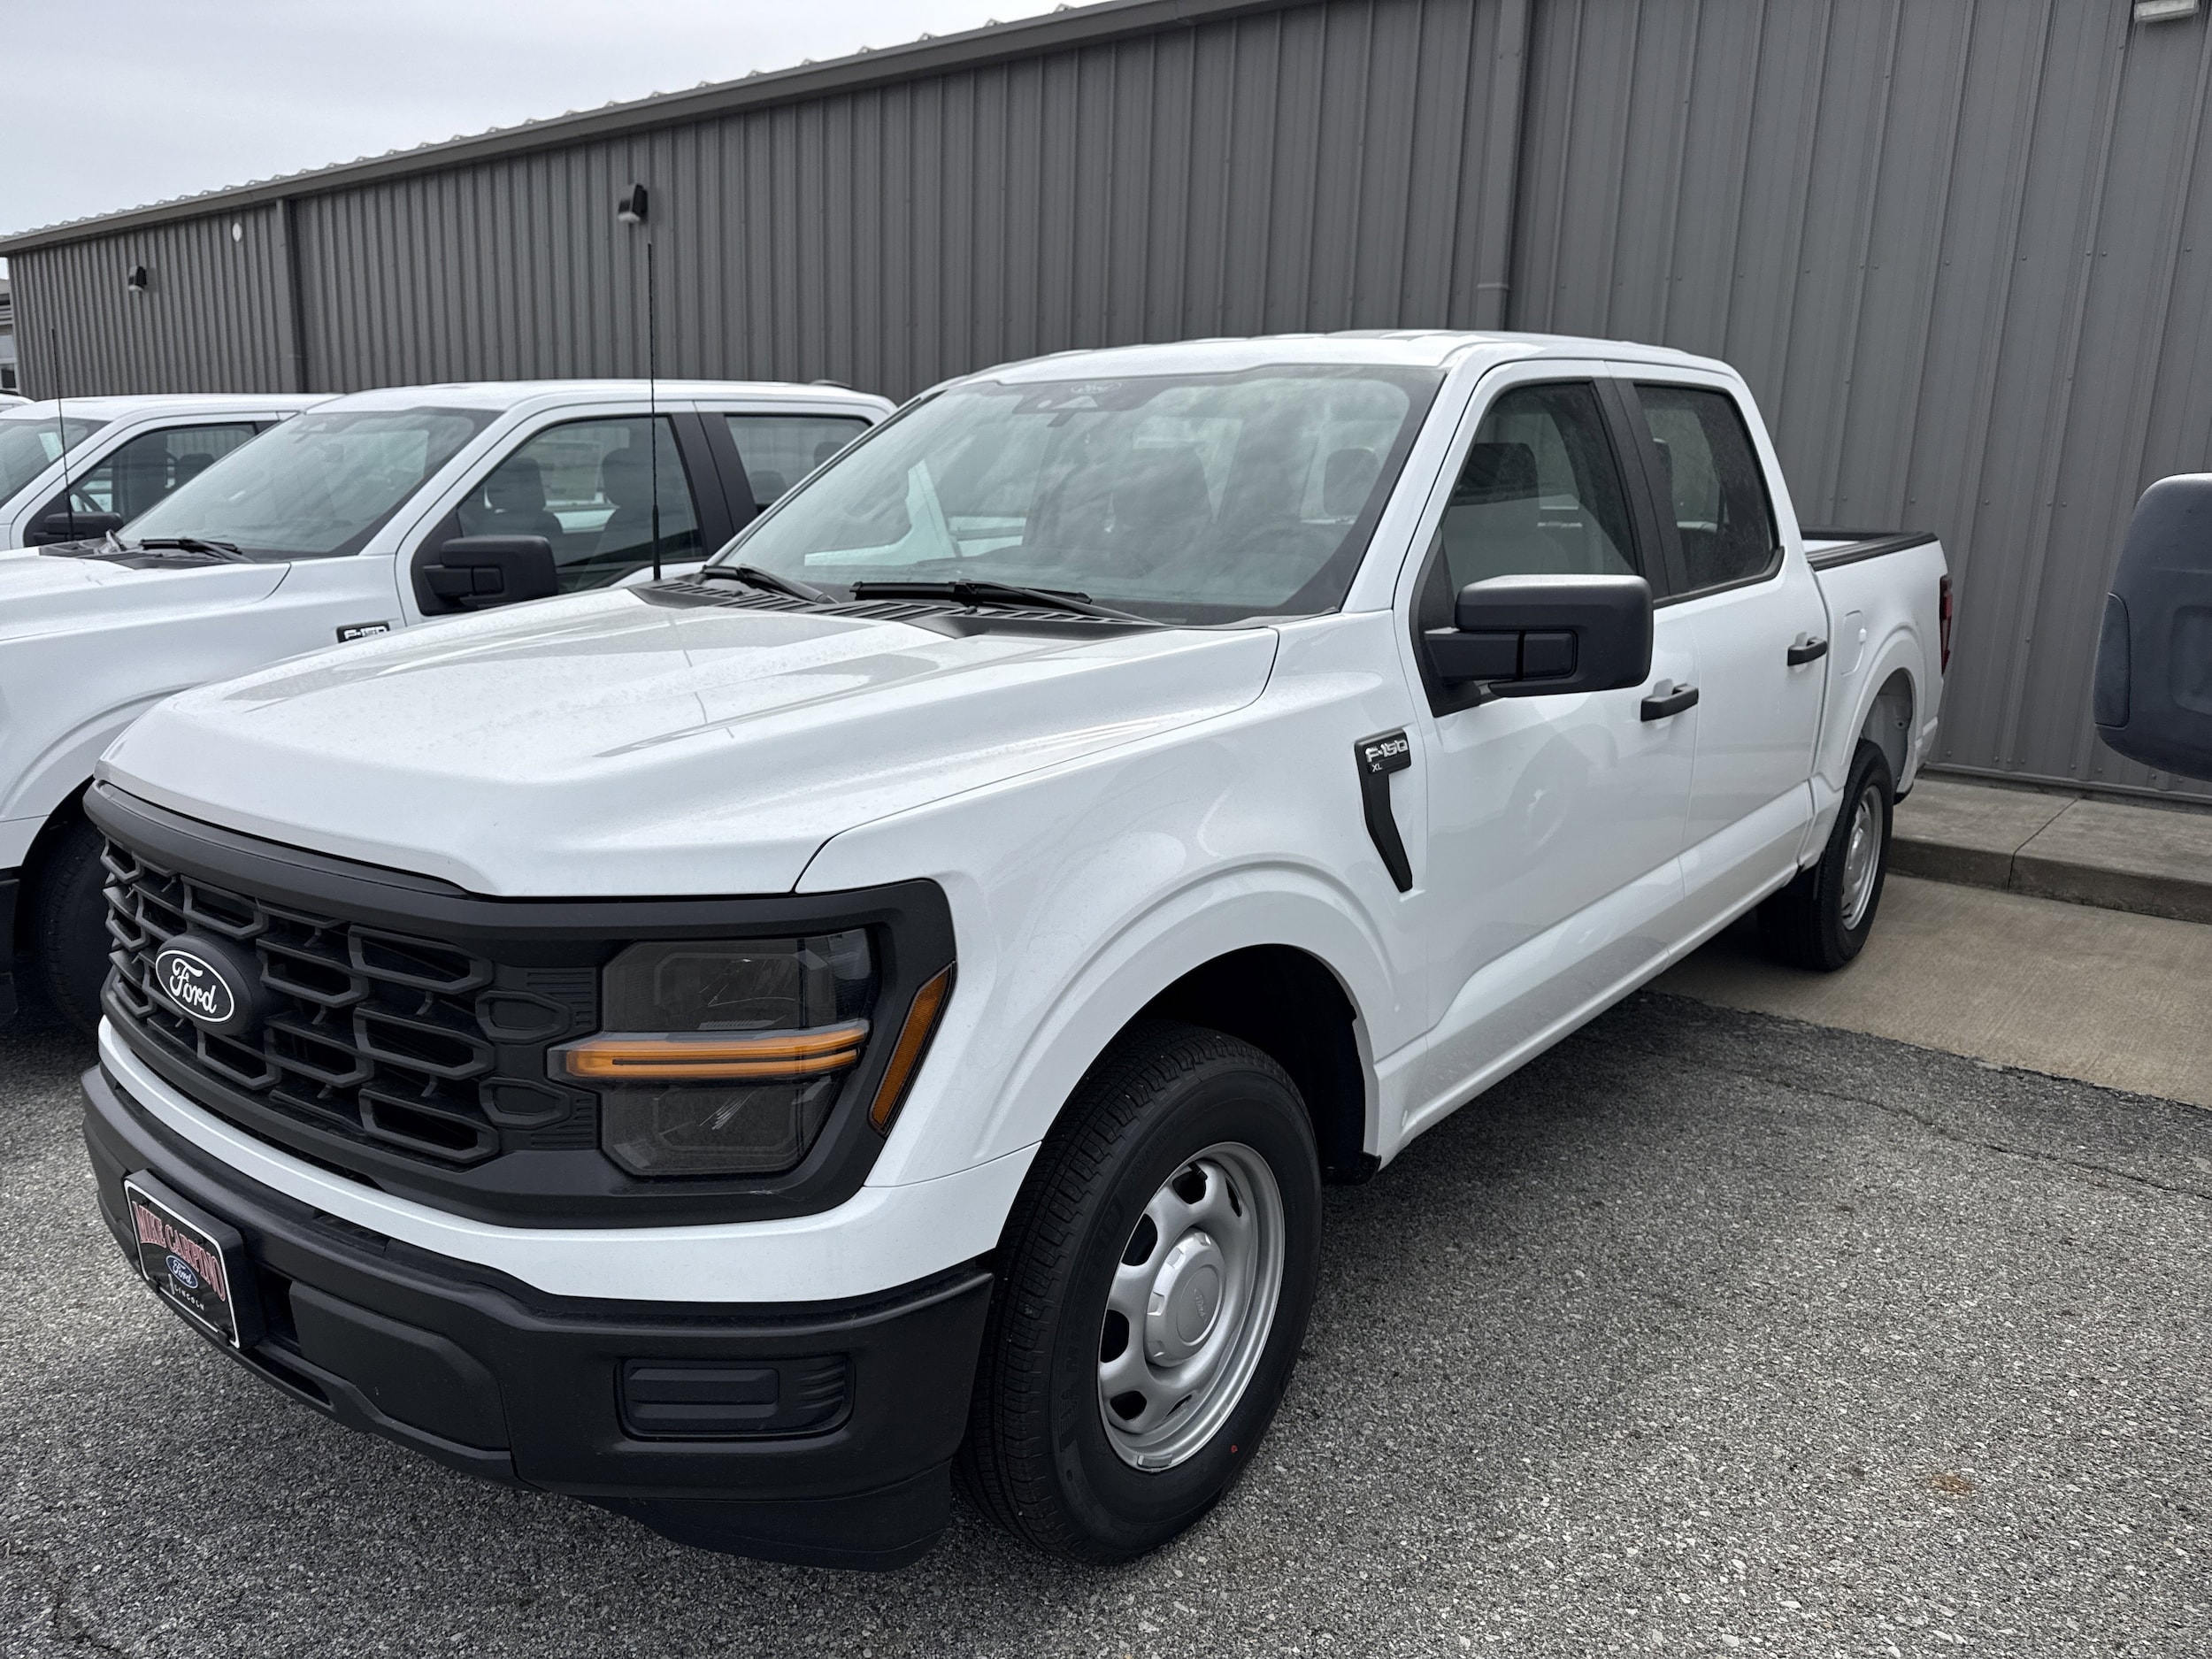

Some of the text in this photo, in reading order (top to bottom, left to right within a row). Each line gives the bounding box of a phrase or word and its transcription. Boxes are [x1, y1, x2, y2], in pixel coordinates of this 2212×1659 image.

[1365, 740, 1409, 763] F-150
[1371, 764, 1383, 772] XL
[169, 958, 218, 1014] Ford
[172, 1259, 193, 1285] Ford
[173, 1284, 204, 1311] LINCOLN
